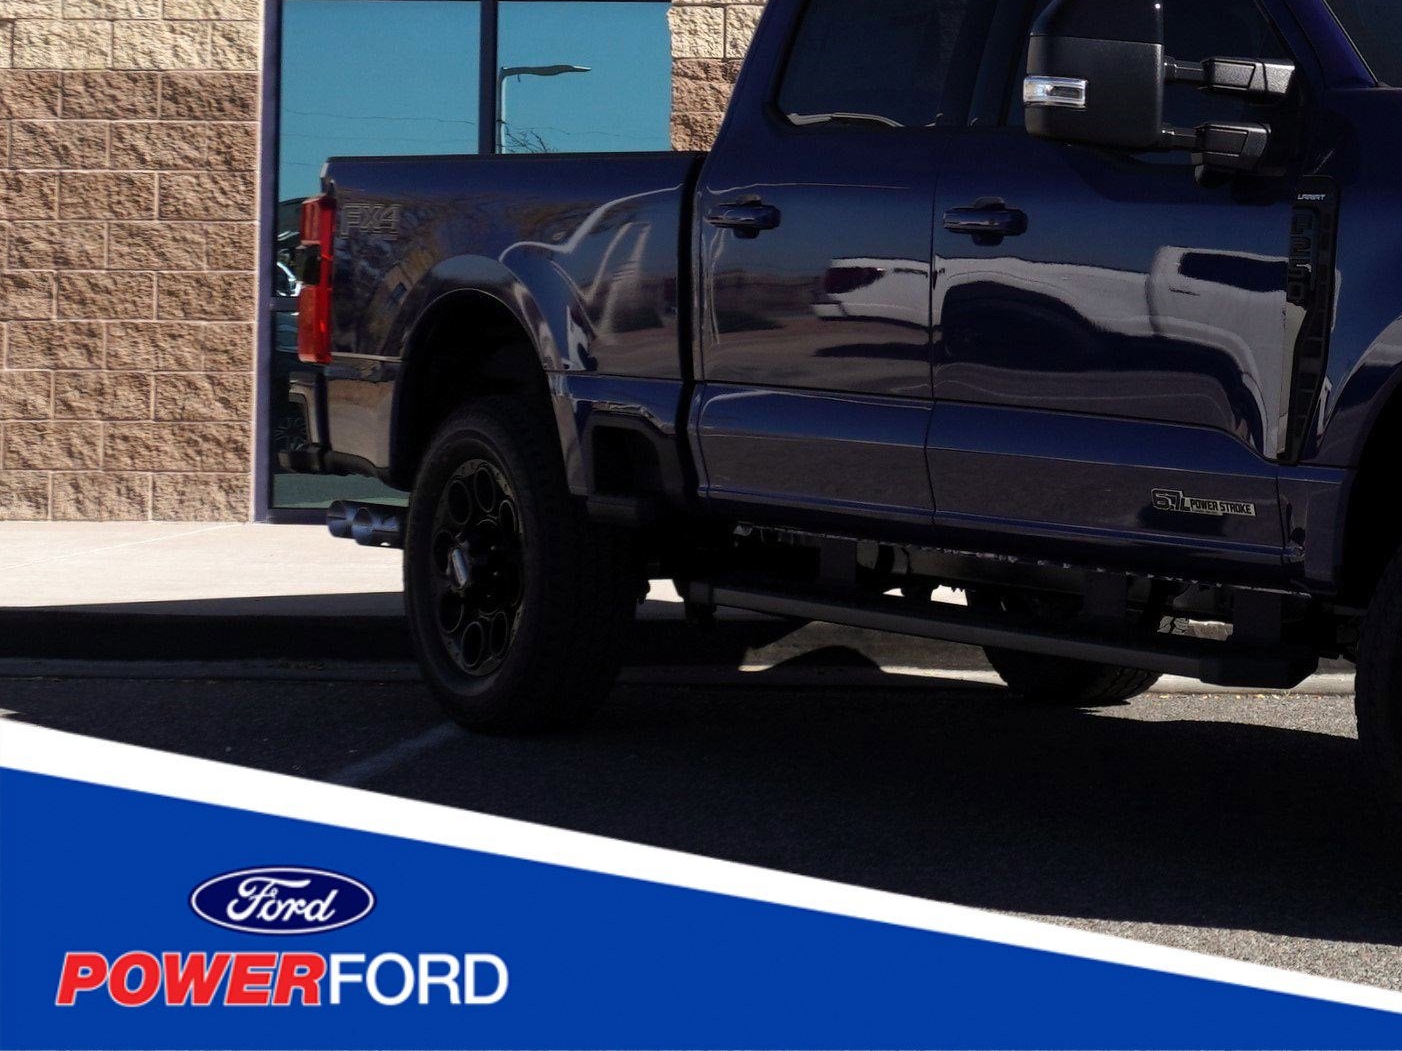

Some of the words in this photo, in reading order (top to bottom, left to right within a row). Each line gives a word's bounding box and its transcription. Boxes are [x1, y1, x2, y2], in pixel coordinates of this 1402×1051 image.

[340, 201, 402, 241] FX4
[1190, 498, 1218, 511] POWER
[1219, 503, 1252, 515] STROKE
